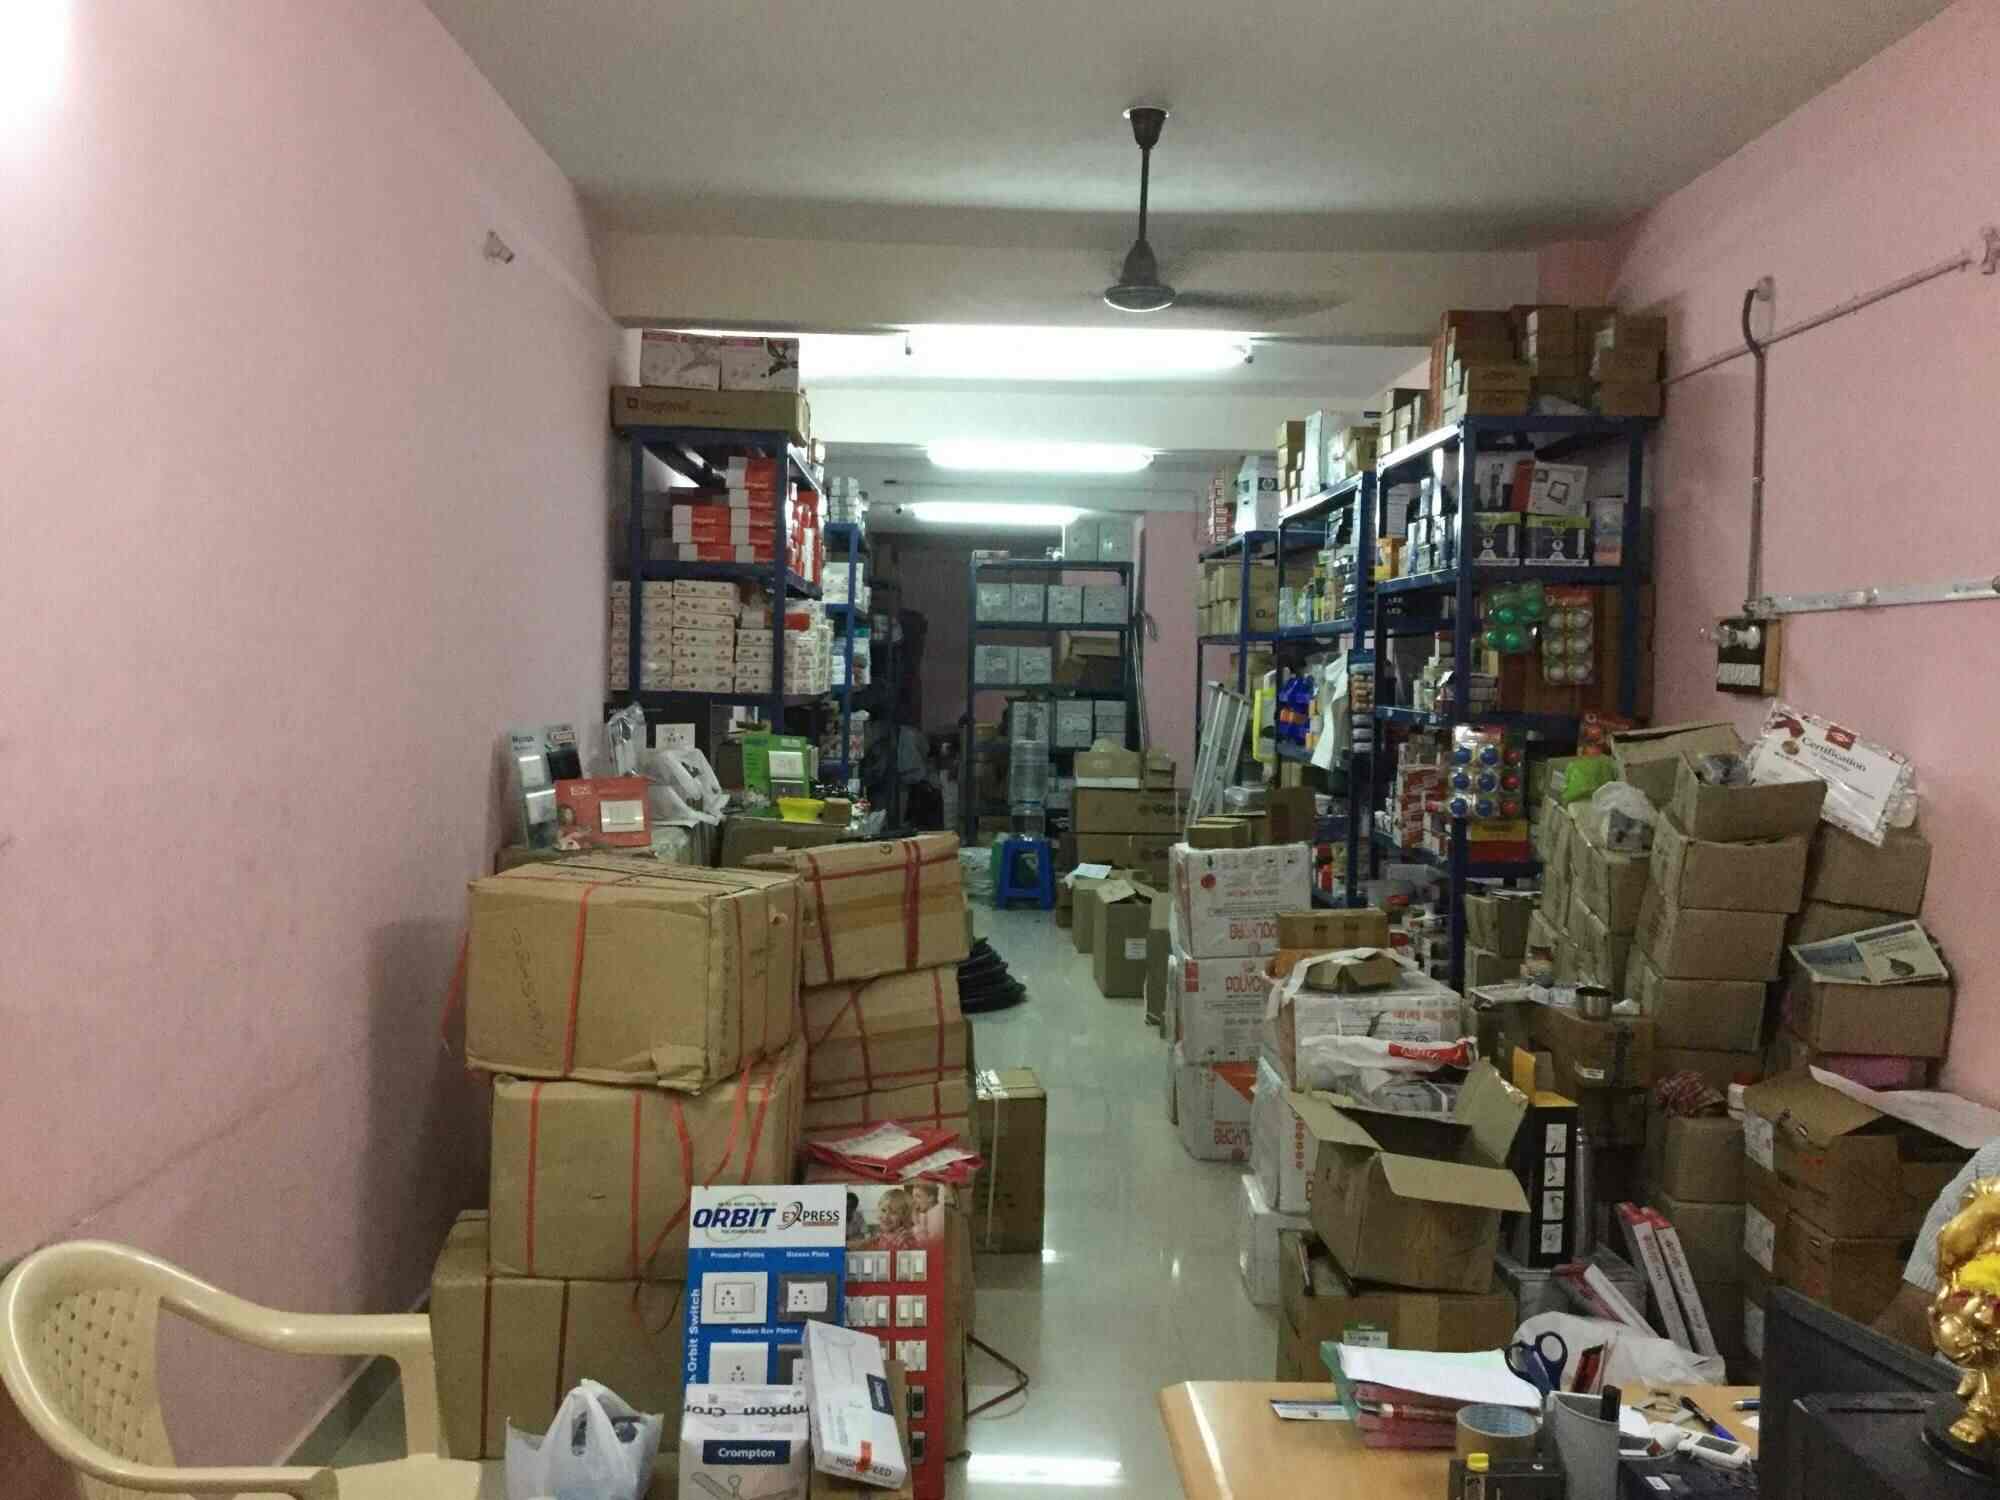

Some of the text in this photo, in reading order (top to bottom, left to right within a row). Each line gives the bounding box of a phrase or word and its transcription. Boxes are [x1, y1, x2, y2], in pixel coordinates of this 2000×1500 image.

[1801, 736, 1867, 772] Certification
[692, 1202, 840, 1228] ORBIT EXPRESS
[688, 1288, 701, 1335] Switch
[687, 1337, 699, 1372] Orbit
[742, 1405, 809, 1418] mpton
[718, 1446, 776, 1459] Crompton
